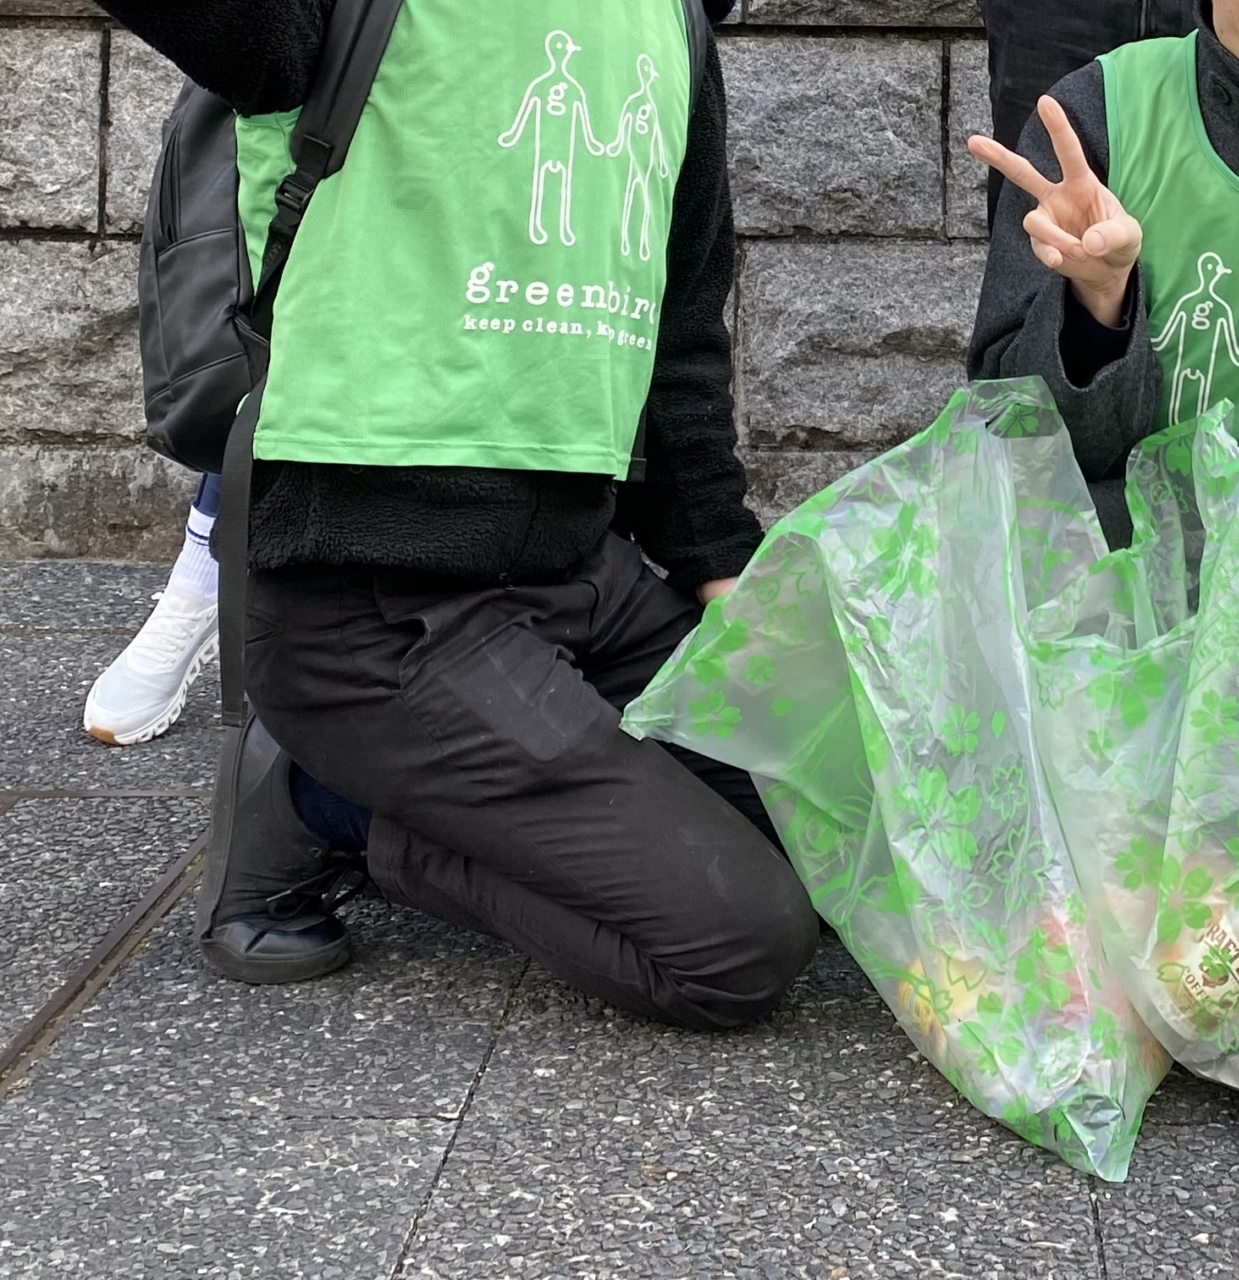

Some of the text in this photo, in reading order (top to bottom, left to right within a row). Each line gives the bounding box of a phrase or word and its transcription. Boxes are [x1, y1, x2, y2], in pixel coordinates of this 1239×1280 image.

[547, 82, 568, 116] g
[465, 261, 608, 308] green
[463, 315, 515, 334] keep
[522, 317, 592, 339] clean,
[1191, 300, 1214, 330] g
